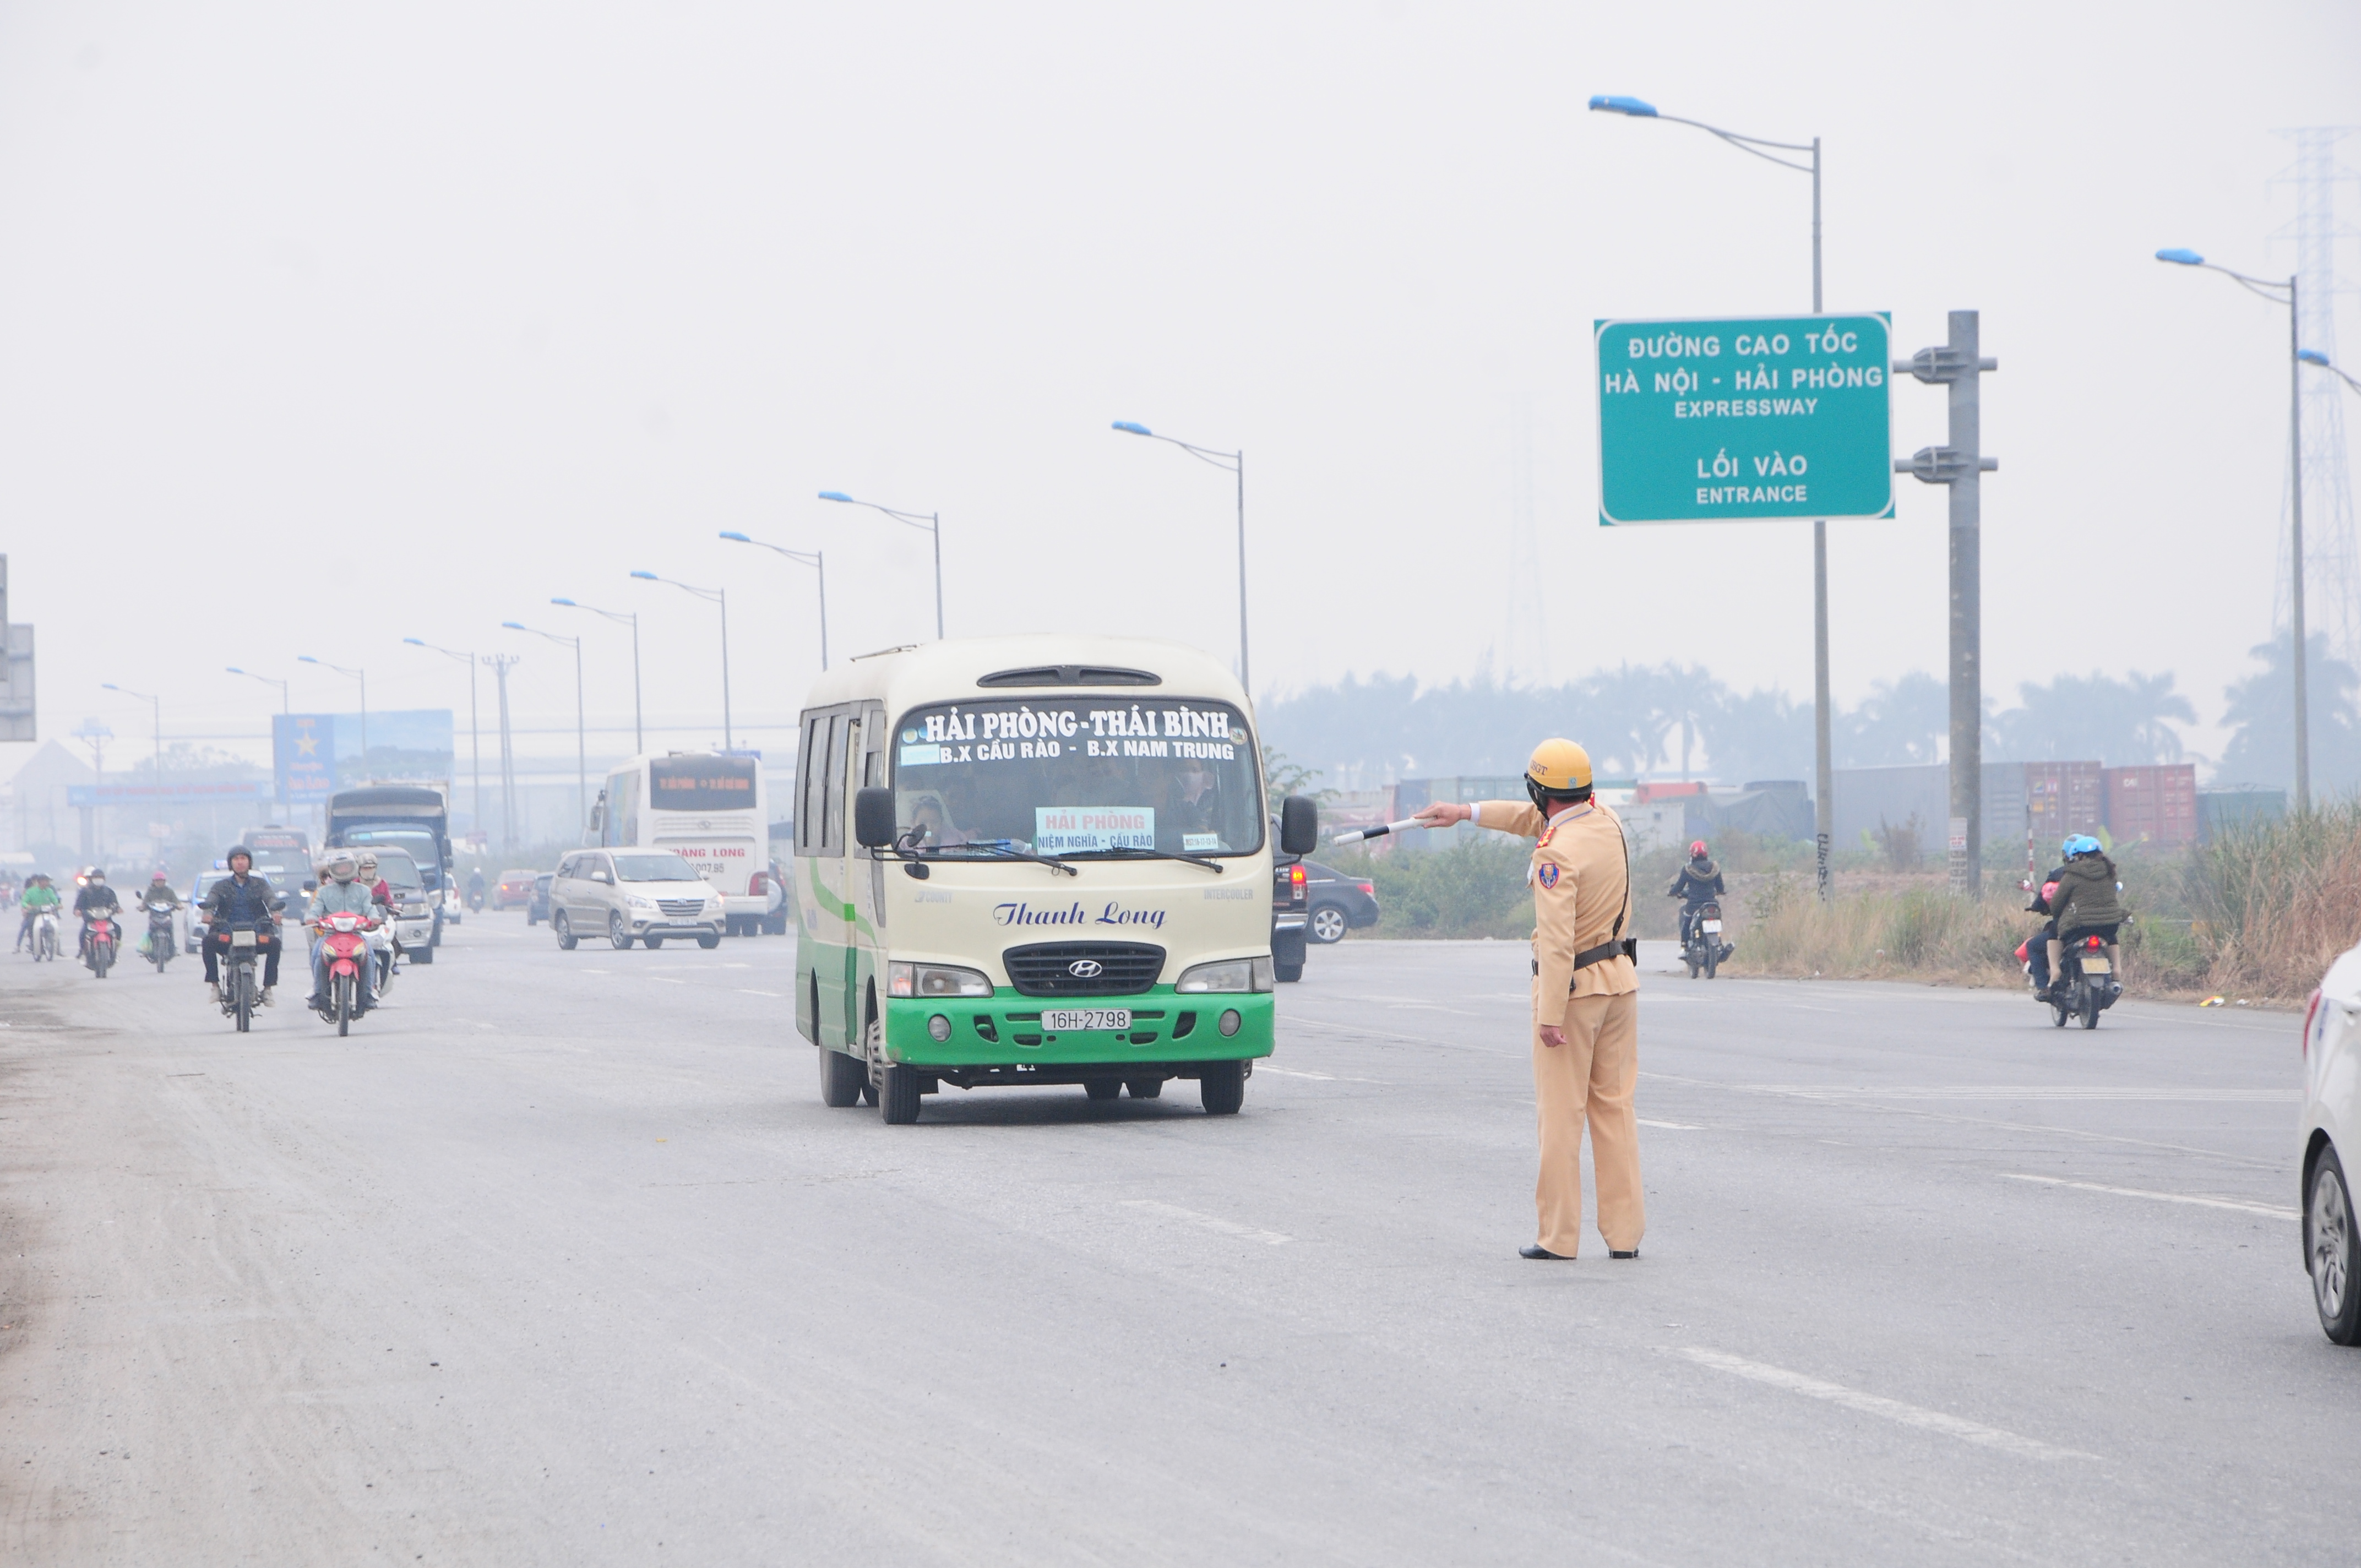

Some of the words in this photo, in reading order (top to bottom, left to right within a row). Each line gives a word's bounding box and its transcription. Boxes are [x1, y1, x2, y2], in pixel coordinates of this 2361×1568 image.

[1629, 331, 1721, 358] ĐƯỜNG
[1735, 334, 1789, 356] CAO
[1805, 323, 1858, 354] TỐC
[1605, 369, 1640, 394] HÀ
[1655, 367, 1698, 396] NỘI
[1736, 363, 1778, 391] HẢI
[1792, 362, 1883, 389] PHÒNG
[1675, 398, 1818, 418] EXPRESSWAY
[1697, 448, 1738, 478] LỐI
[1754, 451, 1807, 476] VÀO
[1696, 485, 1807, 504] ENTRANCE
[924, 706, 976, 742] HẢI
[1162, 705, 1230, 739] BÌNH
[940, 746, 972, 764] B.X
[977, 738, 1015, 761] CẦU
[1020, 738, 1060, 759] RÀO
[1087, 740, 1119, 757] B.X
[1124, 740, 1168, 757] NAM
[1172, 742, 1234, 760] TRUNG
[1046, 809, 1076, 830] HẢI
[1082, 810, 1145, 830] PHÒNG
[1038, 834, 1064, 850] NIỆM
[1067, 834, 1098, 847] NGHĨA
[1133, 832, 1152, 847] RÀO
[713, 848, 745, 857] LONG
[1204, 889, 1254, 900] INTERCOOLER
[993, 902, 1086, 927] Thanh
[1094, 901, 1167, 929] Long
[1051, 1011, 1127, 1030] 16H-2798
